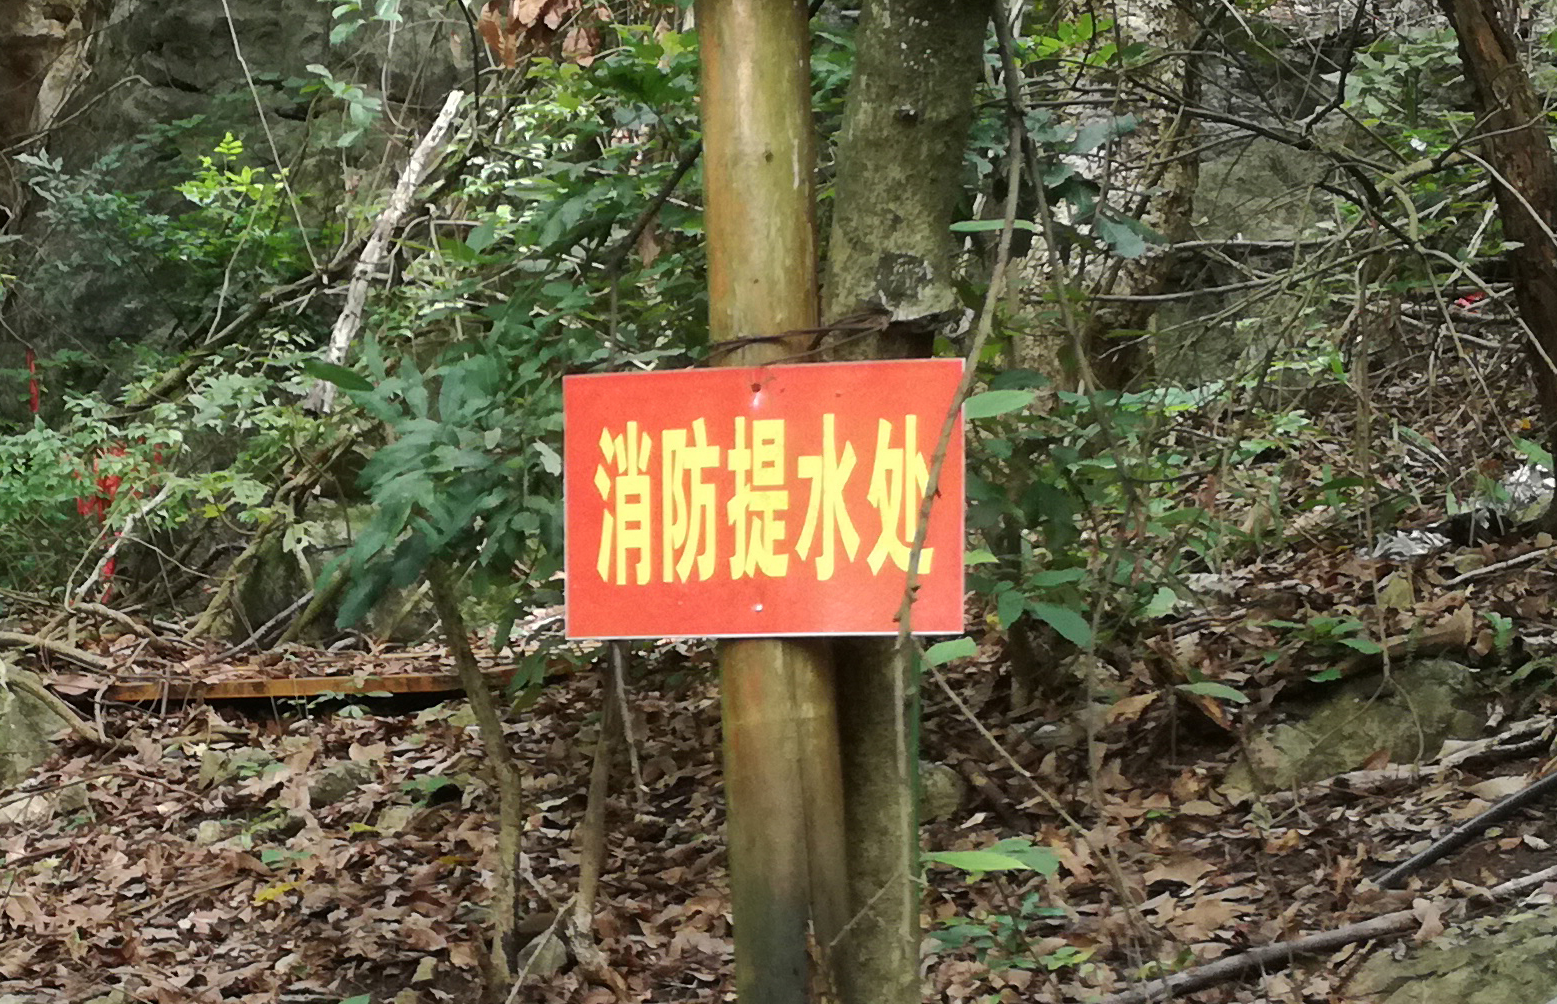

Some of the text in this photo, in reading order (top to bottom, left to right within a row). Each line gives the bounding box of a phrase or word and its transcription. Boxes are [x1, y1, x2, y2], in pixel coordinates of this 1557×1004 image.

[593, 412, 935, 586] 消防提水处
